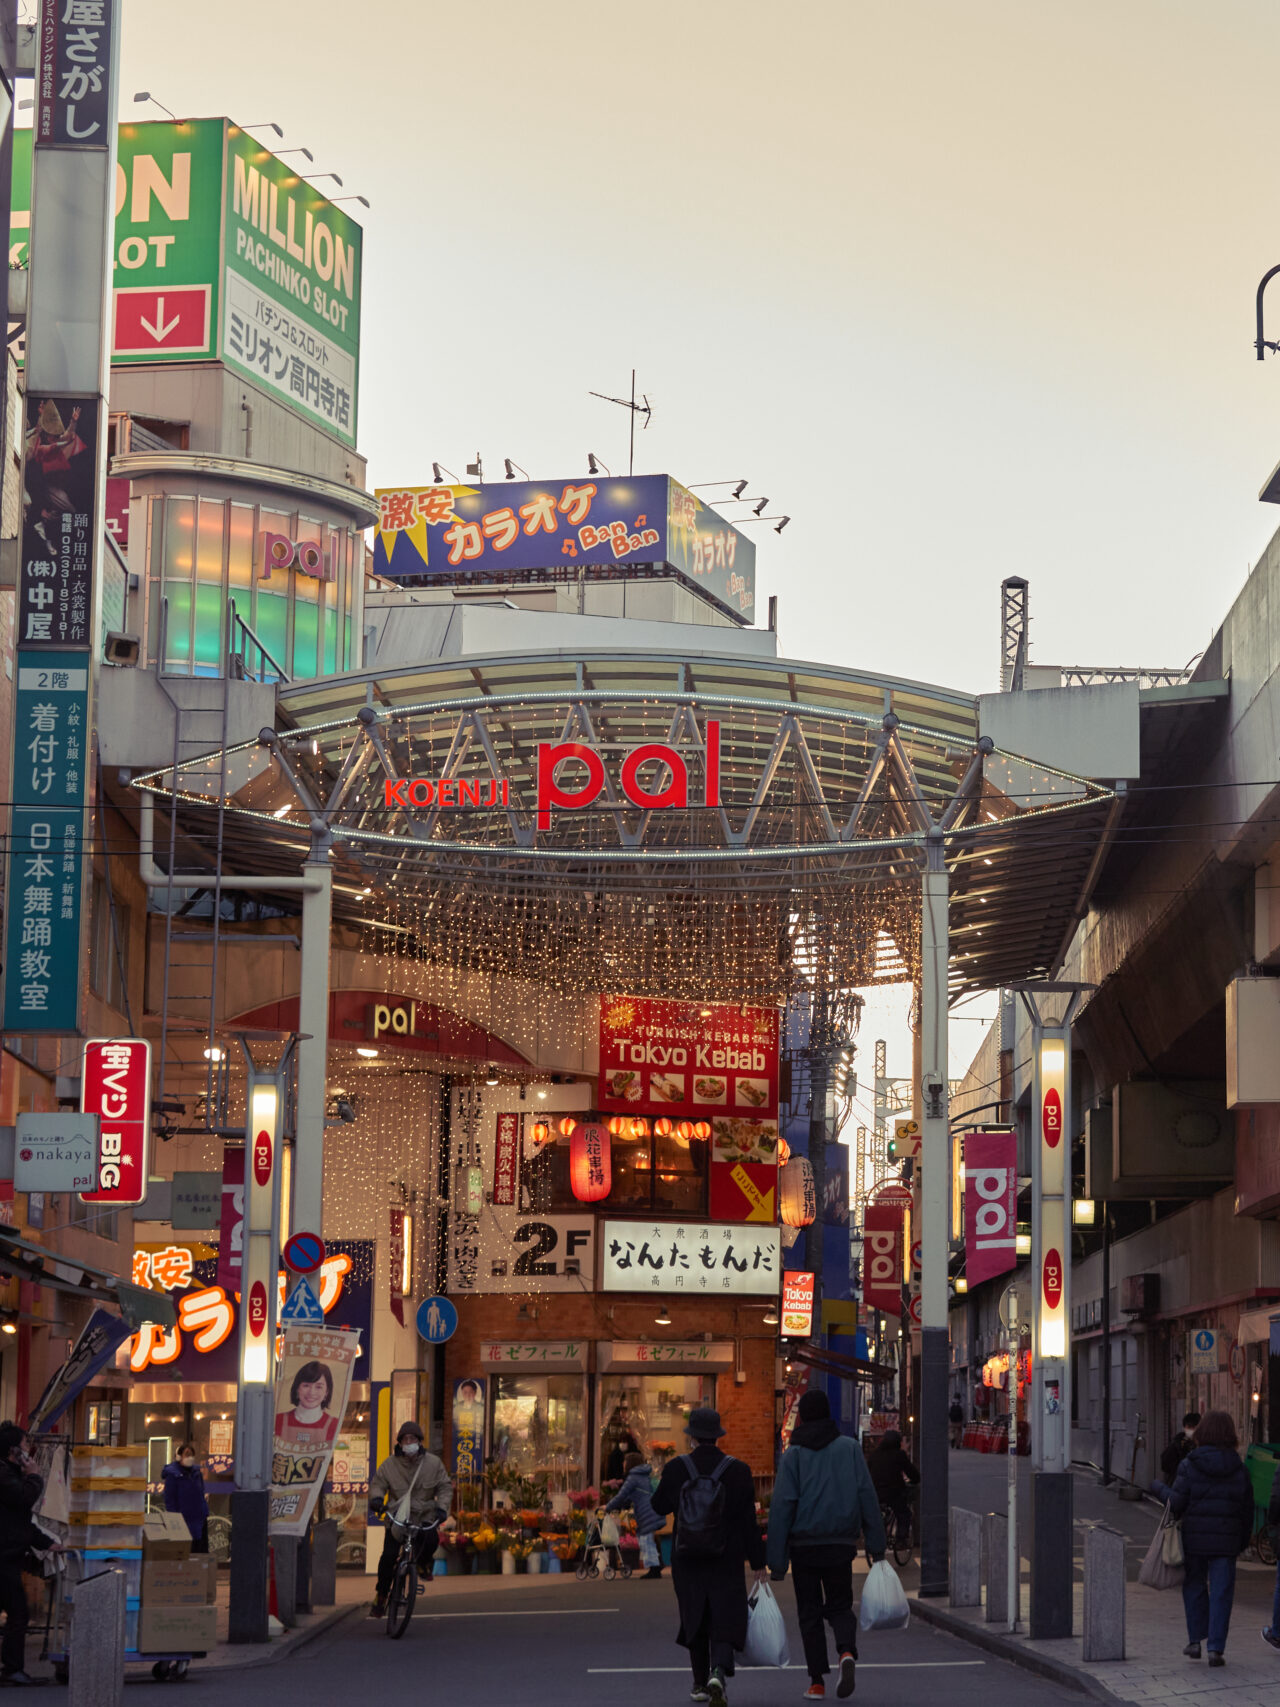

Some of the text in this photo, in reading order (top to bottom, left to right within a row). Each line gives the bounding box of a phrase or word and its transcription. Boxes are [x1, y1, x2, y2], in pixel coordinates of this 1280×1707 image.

[233, 153, 354, 302] MILLION
[236, 227, 349, 332] PACHINKO SLOT
[229, 312, 350, 429] ミリオン高円寺店
[61, 513, 72, 533] 電話
[380, 487, 456, 532] 激安
[443, 483, 597, 565] カラオケ
[671, 487, 697, 531] 激安
[578, 521, 626, 550] Ban
[611, 529, 659, 559] Ban
[261, 531, 337, 582] pal
[692, 531, 737, 575] カラオケ
[25, 582, 54, 640] 中屋
[38, 672, 69, 689] 2階
[27, 702, 60, 795] 着付け
[384, 719, 721, 832] KOENJI pal
[20, 822, 54, 1011] 日本舞踊教室
[374, 1000, 416, 1039] pal
[636, 1025, 697, 1040] TURKISH
[704, 1030, 750, 1044] KEBAB
[613, 1038, 766, 1071] Tokyo Kebab
[100, 1045, 132, 1190] 宝くじ BIG
[1045, 1105, 1060, 1131] pal
[36, 1147, 91, 1164] nakaya
[256, 1146, 270, 1170] pal
[73, 1174, 92, 1187] pal
[965, 1168, 1016, 1250] pal
[513, 1222, 591, 1276] 2F
[652, 1227, 732, 1241] 大衆酒場
[609, 1239, 776, 1273] なんたもんだ
[864, 1231, 901, 1290] pal
[651, 1275, 731, 1288] 高円寺店
[784, 1287, 813, 1301] Tokyo
[1045, 1266, 1060, 1291] pal
[251, 1298, 264, 1321] pal
[784, 1301, 811, 1311] Kebab
[488, 1343, 579, 1361] 花 ゼフィール
[637, 1344, 709, 1361] 花 ゼフィール
